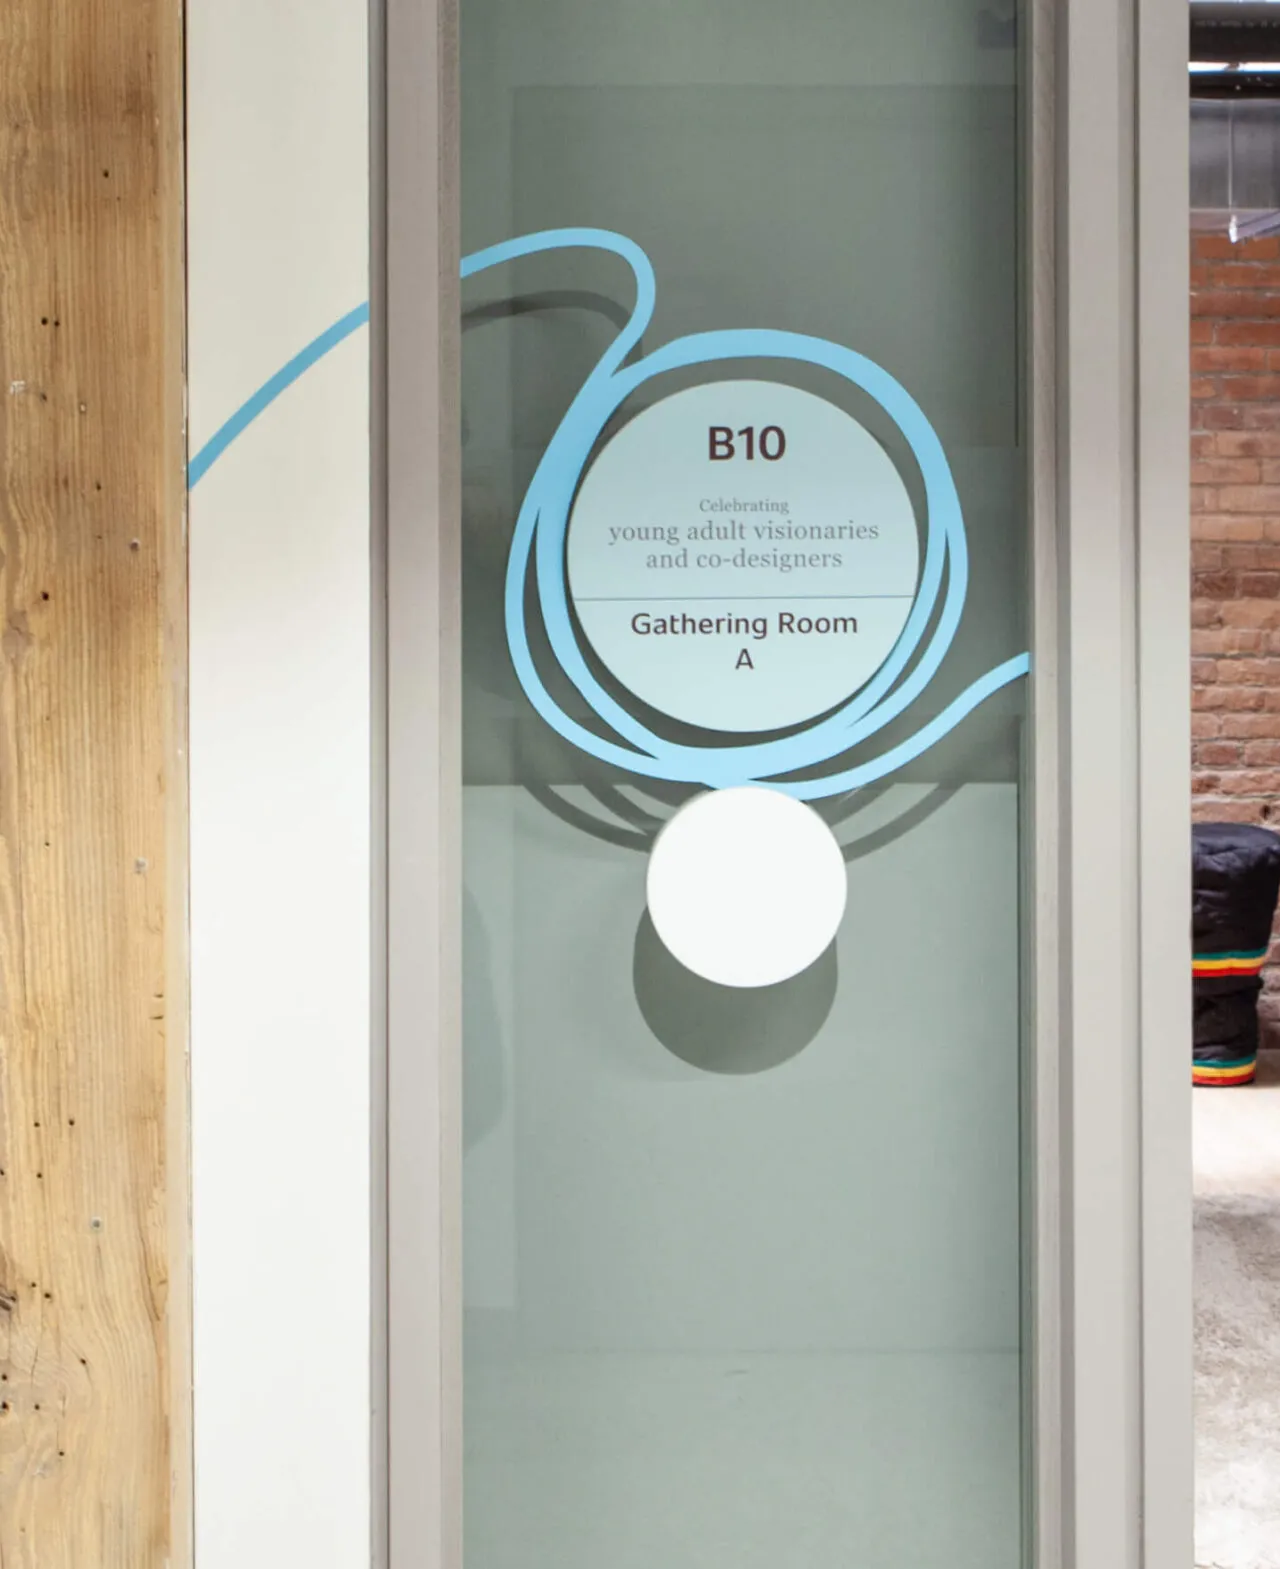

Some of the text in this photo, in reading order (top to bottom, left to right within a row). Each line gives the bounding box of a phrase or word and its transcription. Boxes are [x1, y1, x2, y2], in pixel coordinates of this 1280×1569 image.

[708, 425, 787, 461] B10
[699, 498, 790, 514] Celebrating
[608, 519, 880, 546] young adult visionaries
[645, 547, 843, 573] and co-designers
[631, 612, 858, 640] Gathering Room
[734, 648, 755, 670] A
